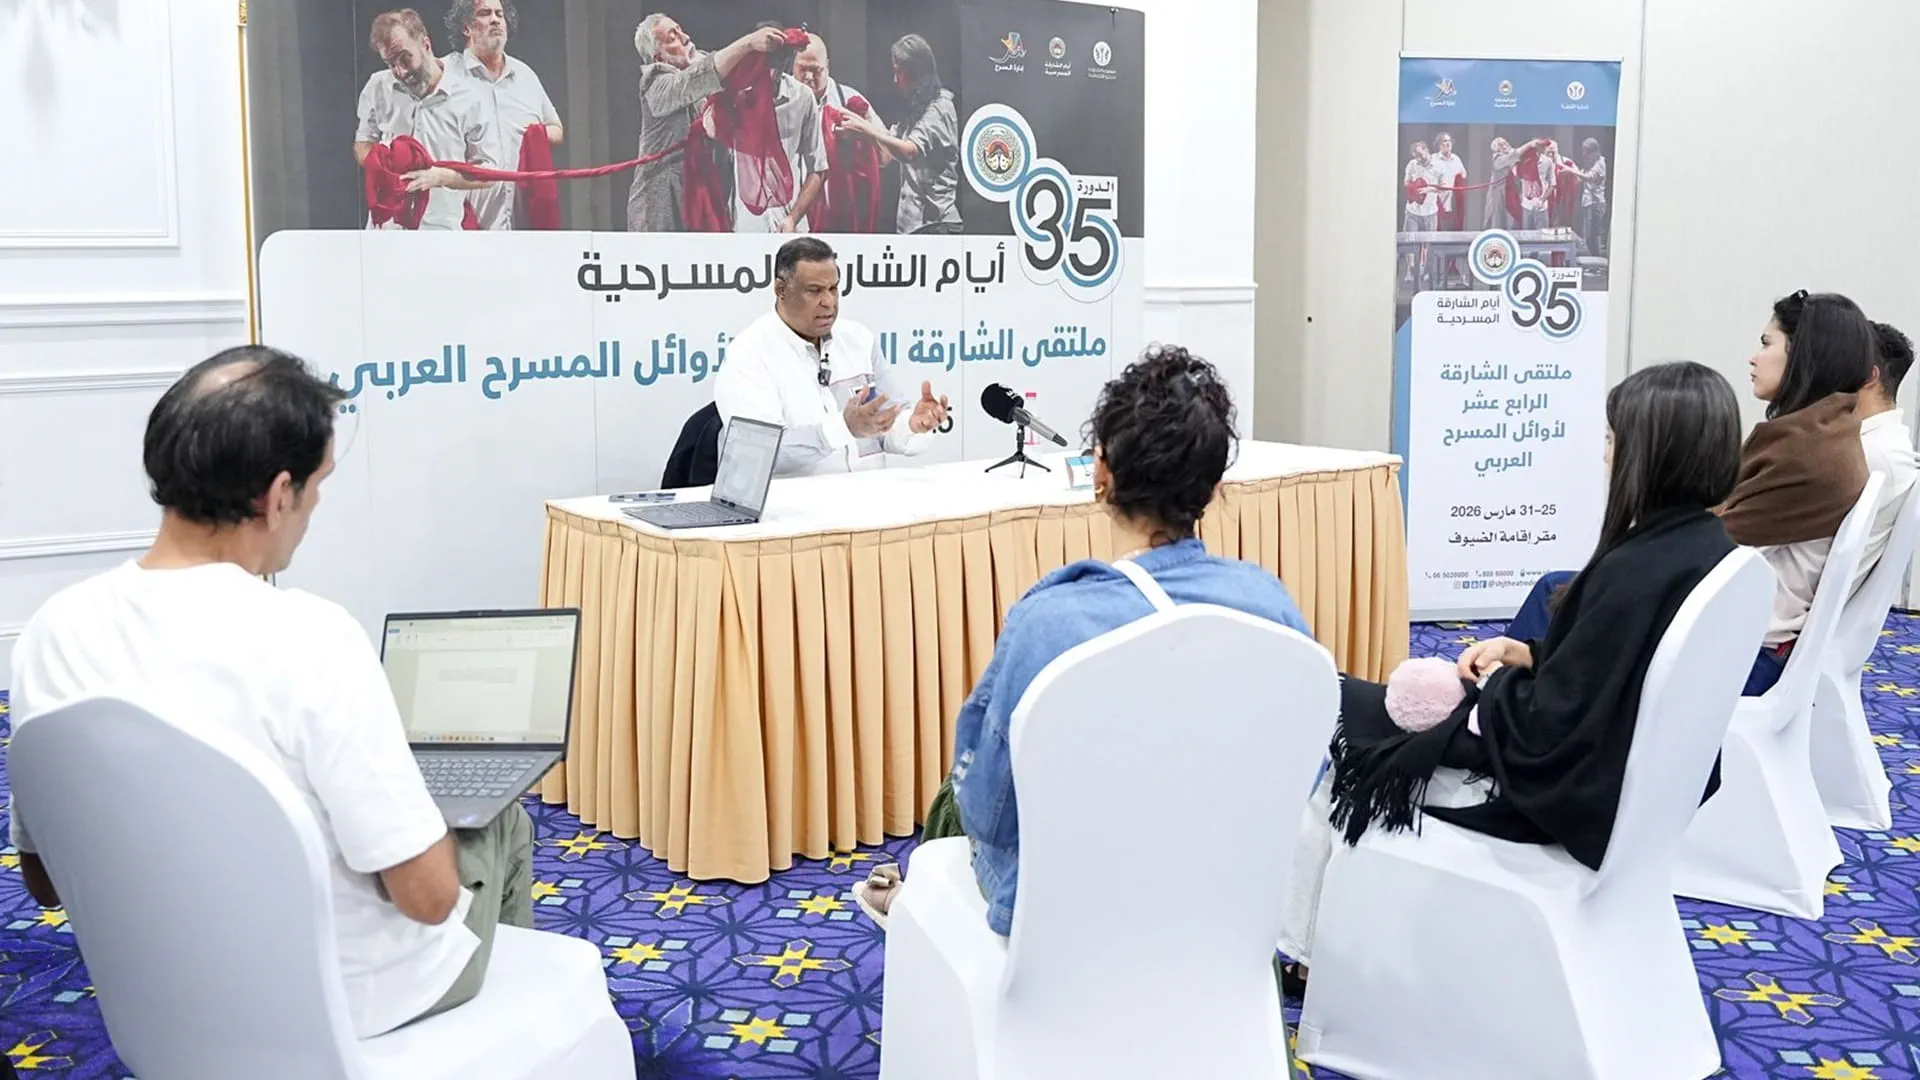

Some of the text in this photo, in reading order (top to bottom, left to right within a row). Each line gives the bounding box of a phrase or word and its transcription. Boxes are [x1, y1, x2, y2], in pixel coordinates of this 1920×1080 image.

[1076, 180, 1115, 196] الدورة
[1025, 179, 1111, 277] 35
[577, 241, 1005, 303] أيام الشار لمسرحية
[1437, 296, 1500, 310] أيام الشارقة
[1512, 271, 1577, 330] 35
[1437, 313, 1500, 326] المسرحية
[908, 320, 1013, 372] الشارقة
[1022, 325, 1107, 368] ملتقى
[328, 332, 735, 414] أوائل المسرح العربي
[1440, 360, 1572, 384] ملتقى الشارقة
[1462, 389, 1548, 416] الرابع عشر
[1443, 420, 1566, 447] لأوائل المسرح
[1475, 451, 1532, 477] العربي
[1450, 505, 1482, 517] 2026
[1483, 505, 1516, 520] مارس
[1448, 530, 1557, 547] مقر إقامة الضيوف
